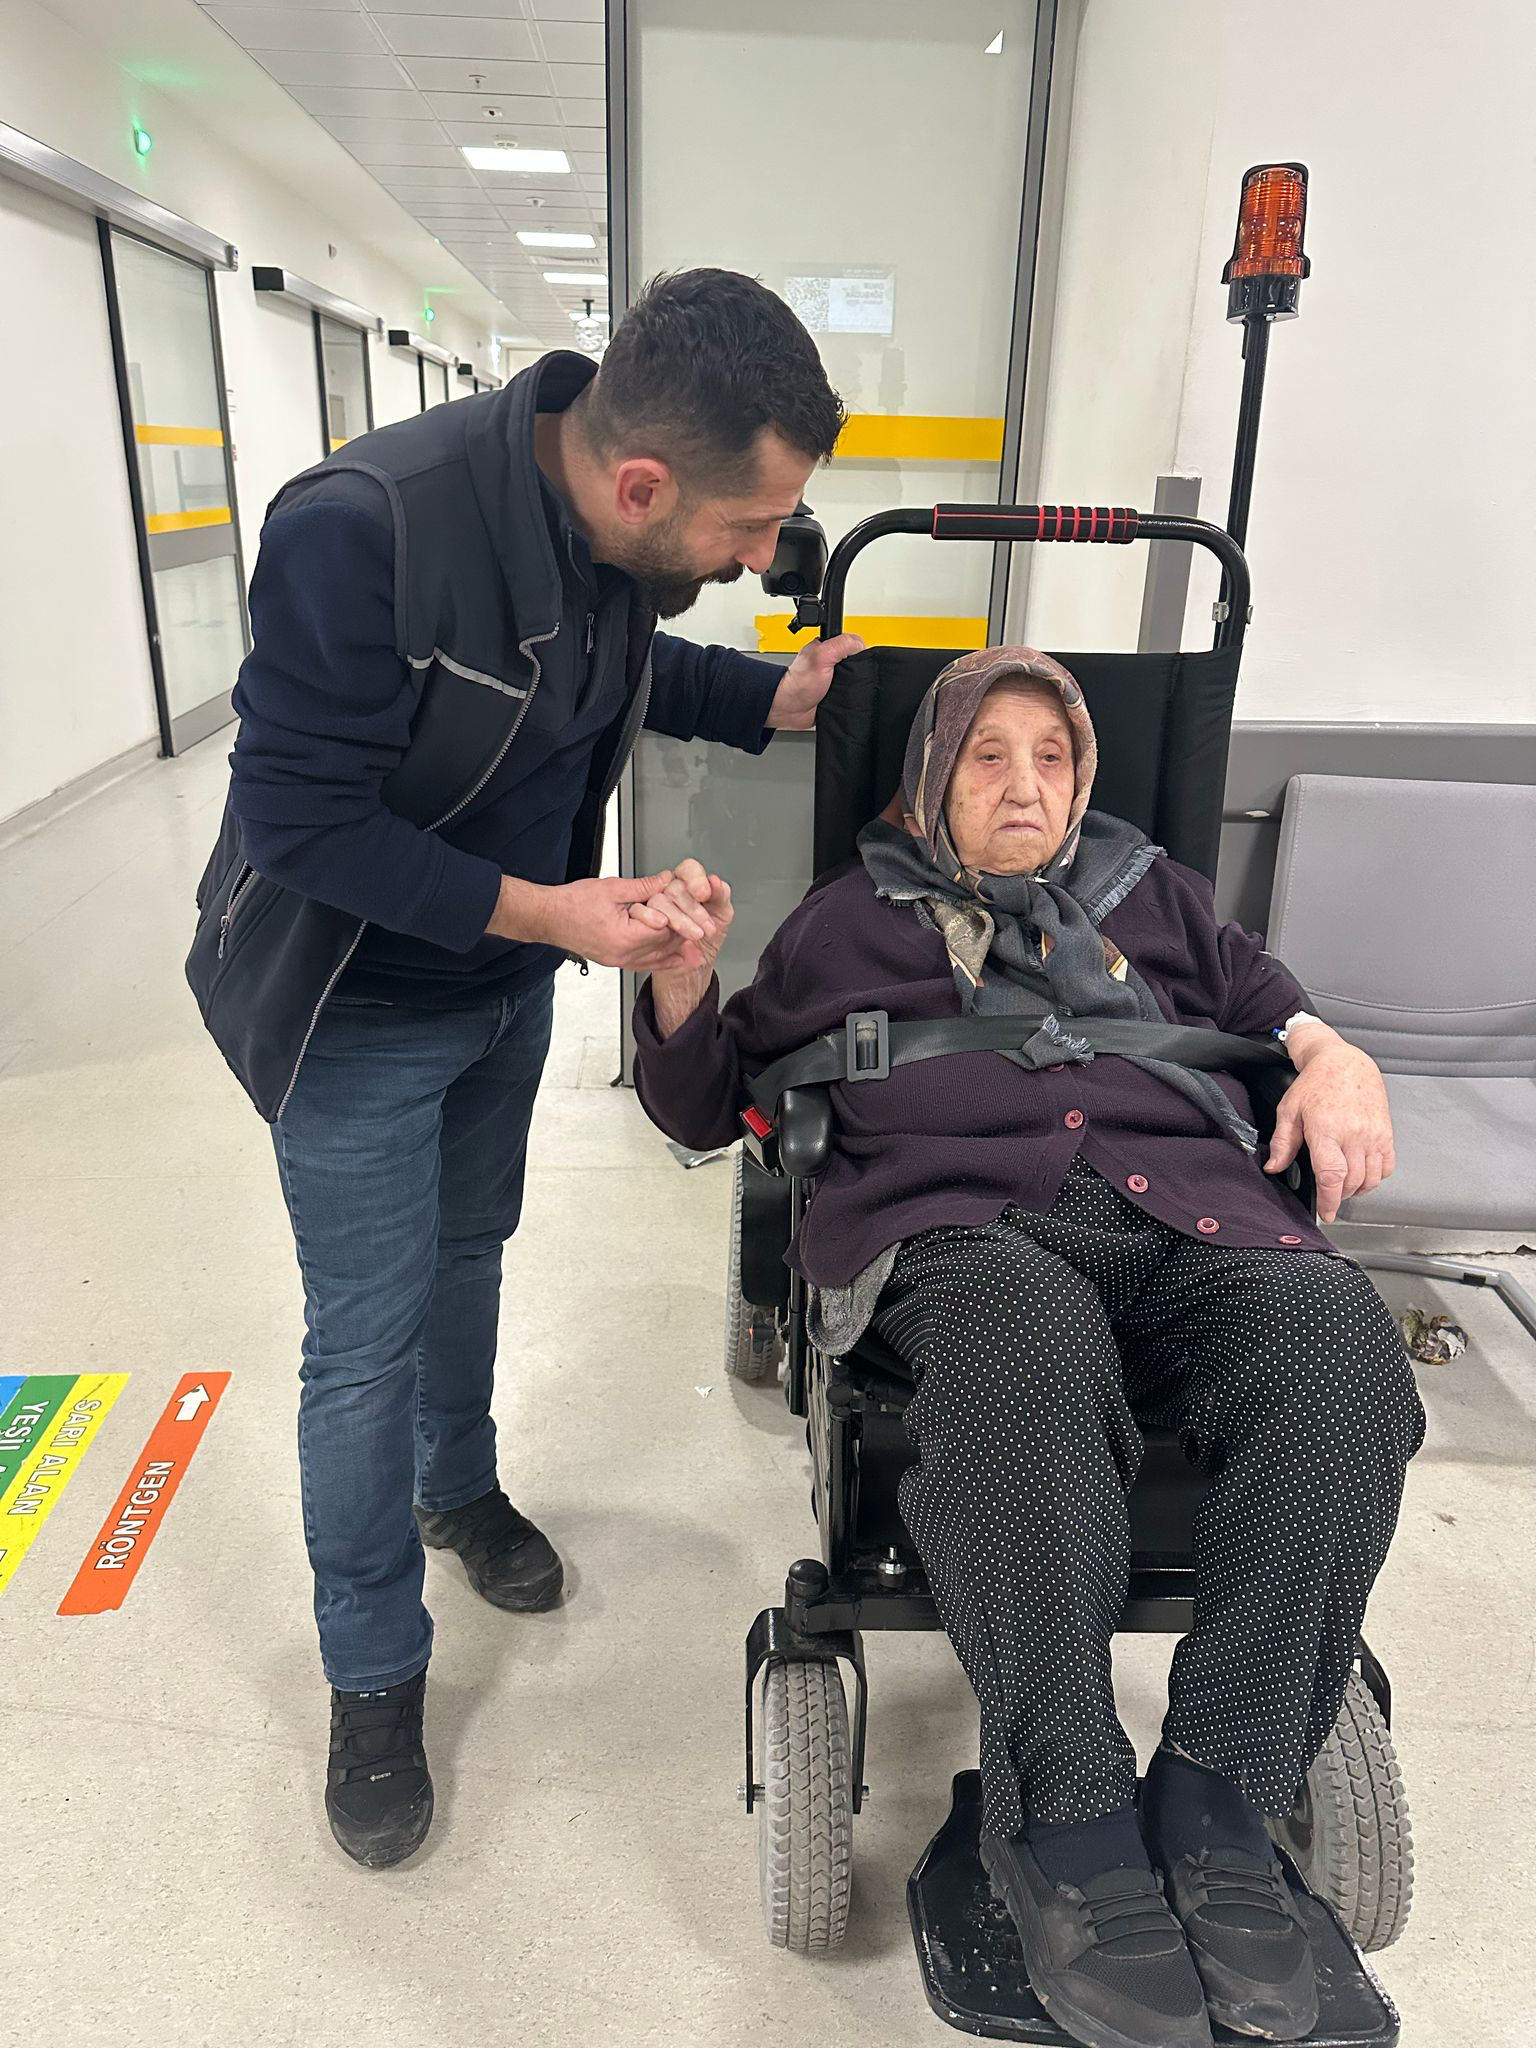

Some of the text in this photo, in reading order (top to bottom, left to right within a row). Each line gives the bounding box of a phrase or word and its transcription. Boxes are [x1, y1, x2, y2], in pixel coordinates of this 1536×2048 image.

[7, 1399, 102, 1515] SARI ALAN
[94, 1461, 175, 1570] RÖNTGEN
